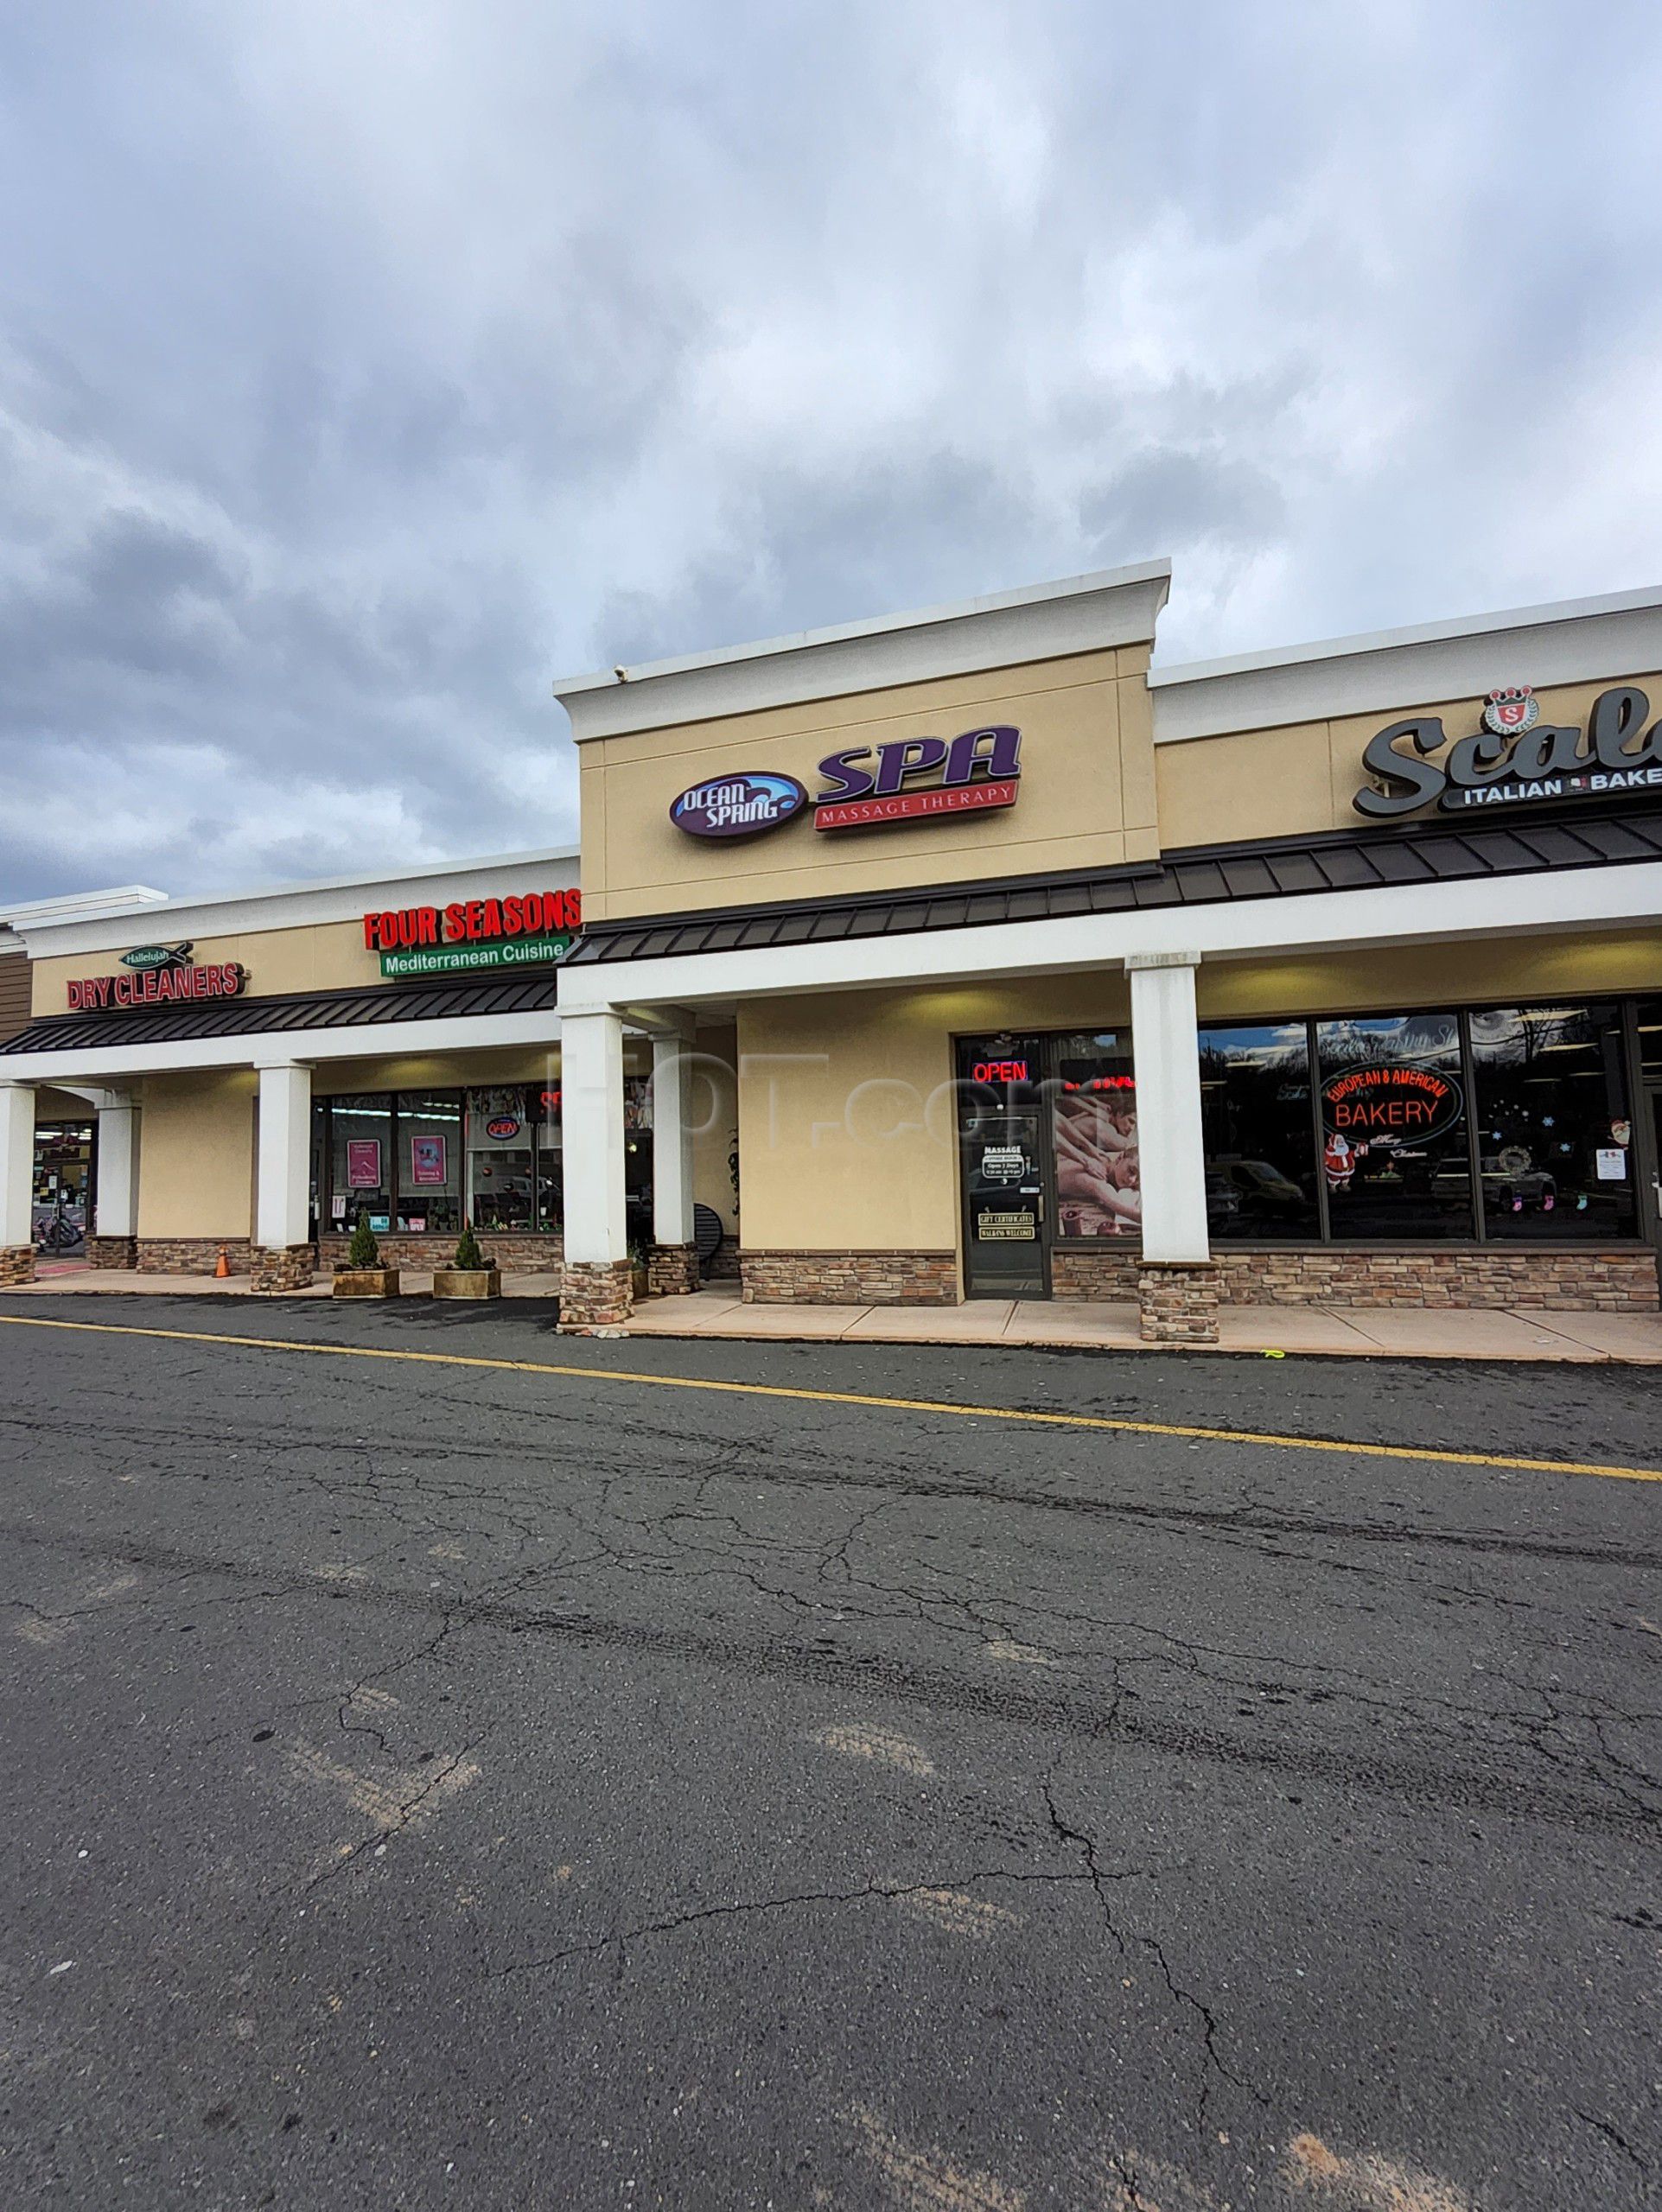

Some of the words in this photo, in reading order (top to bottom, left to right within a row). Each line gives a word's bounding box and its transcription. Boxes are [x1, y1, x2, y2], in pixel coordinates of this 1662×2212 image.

[1505, 707, 1518, 722] S
[816, 725, 1022, 804] SPA
[684, 783, 748, 811] OCEAN
[821, 802, 915, 823] MASSAGE
[921, 788, 1012, 810] THERAPY
[1464, 779, 1562, 805] ITALIAN
[706, 798, 779, 829] SPRING
[363, 906, 437, 950] FOUR
[444, 887, 582, 941] SEASONS
[126, 950, 169, 964] Hallelujah
[385, 950, 499, 973] Mediterranean
[502, 941, 564, 963] Cuisine
[67, 976, 111, 1010] DRY
[114, 962, 239, 1006] CLEANERS
[974, 1062, 1027, 1082] OPEN
[1327, 1070, 1381, 1103] EUROPEAN
[1391, 1068, 1449, 1098] AMERICAN
[1335, 1100, 1439, 1128] BAKERY
[488, 1122, 517, 1135] OPEN
[984, 1146, 1022, 1154] MASSAGE
